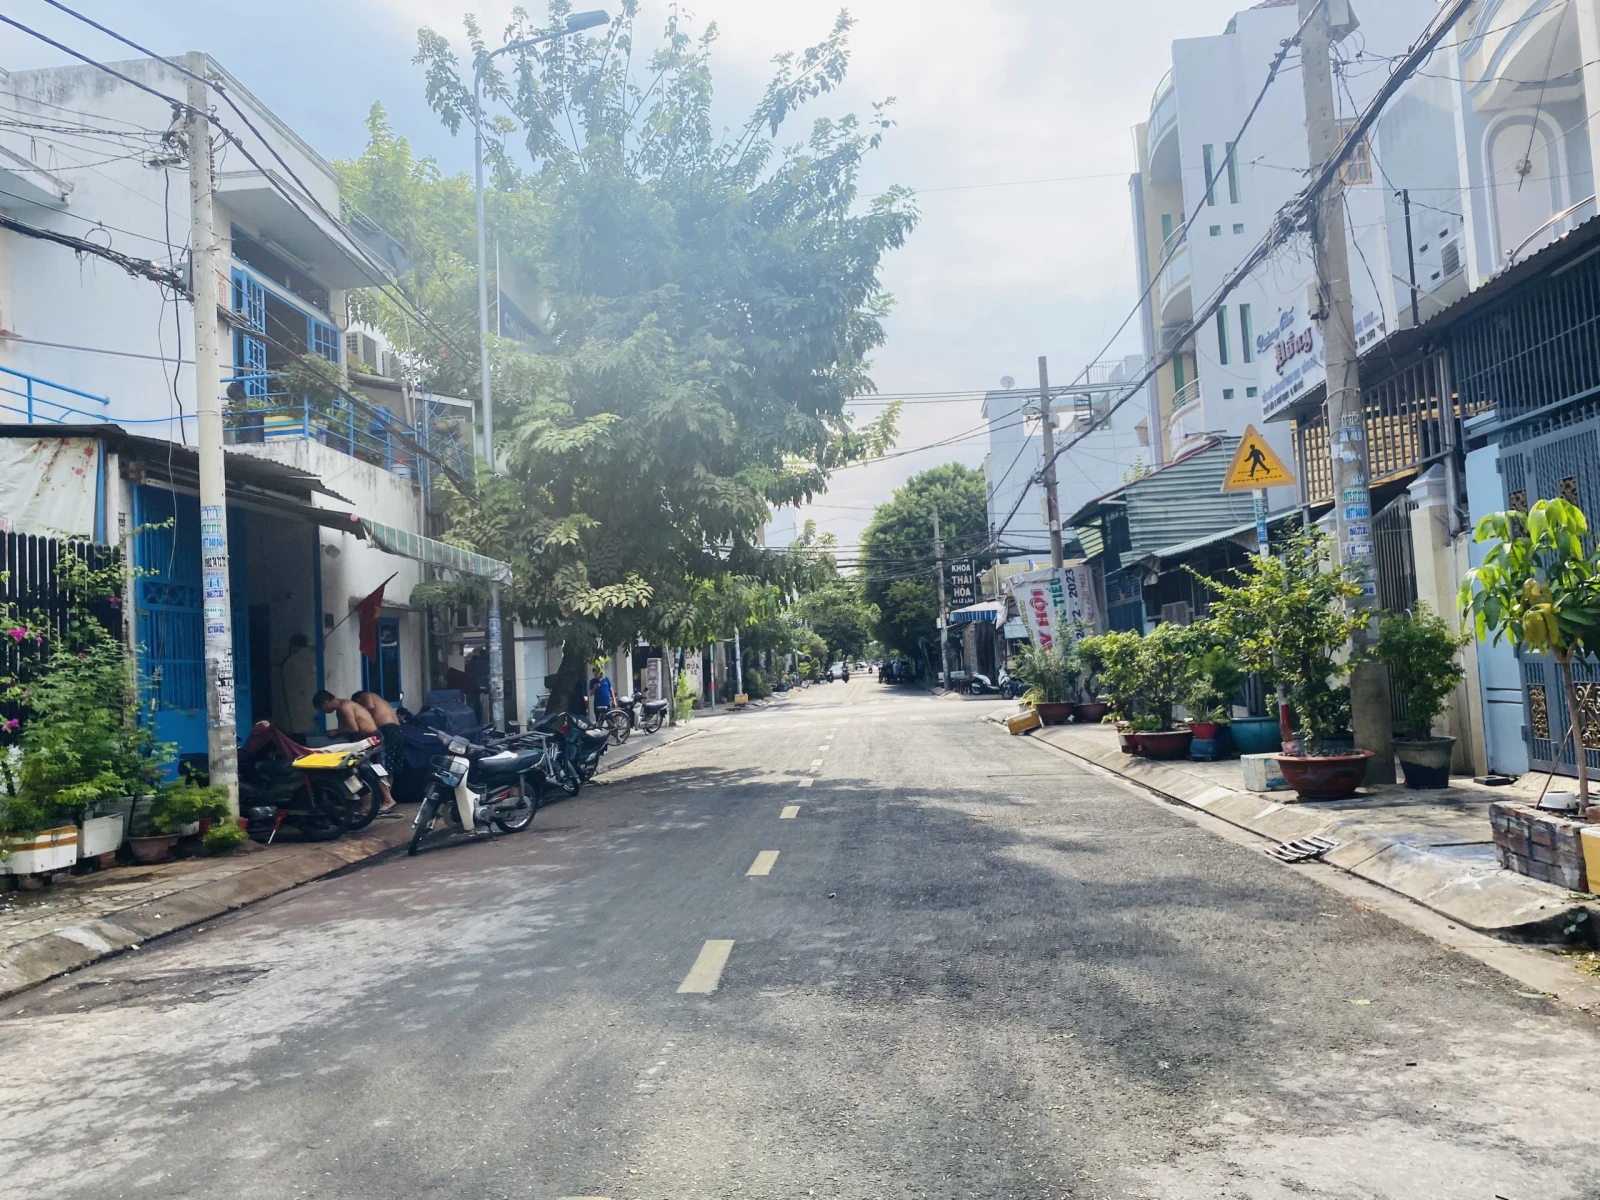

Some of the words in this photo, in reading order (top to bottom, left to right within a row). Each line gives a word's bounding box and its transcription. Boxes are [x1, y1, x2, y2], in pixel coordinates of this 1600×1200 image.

[951, 564, 971, 572] KHOA
[951, 572, 973, 585] THÁI
[1065, 568, 1078, 598] 2023
[1029, 589, 1049, 626] HỘI
